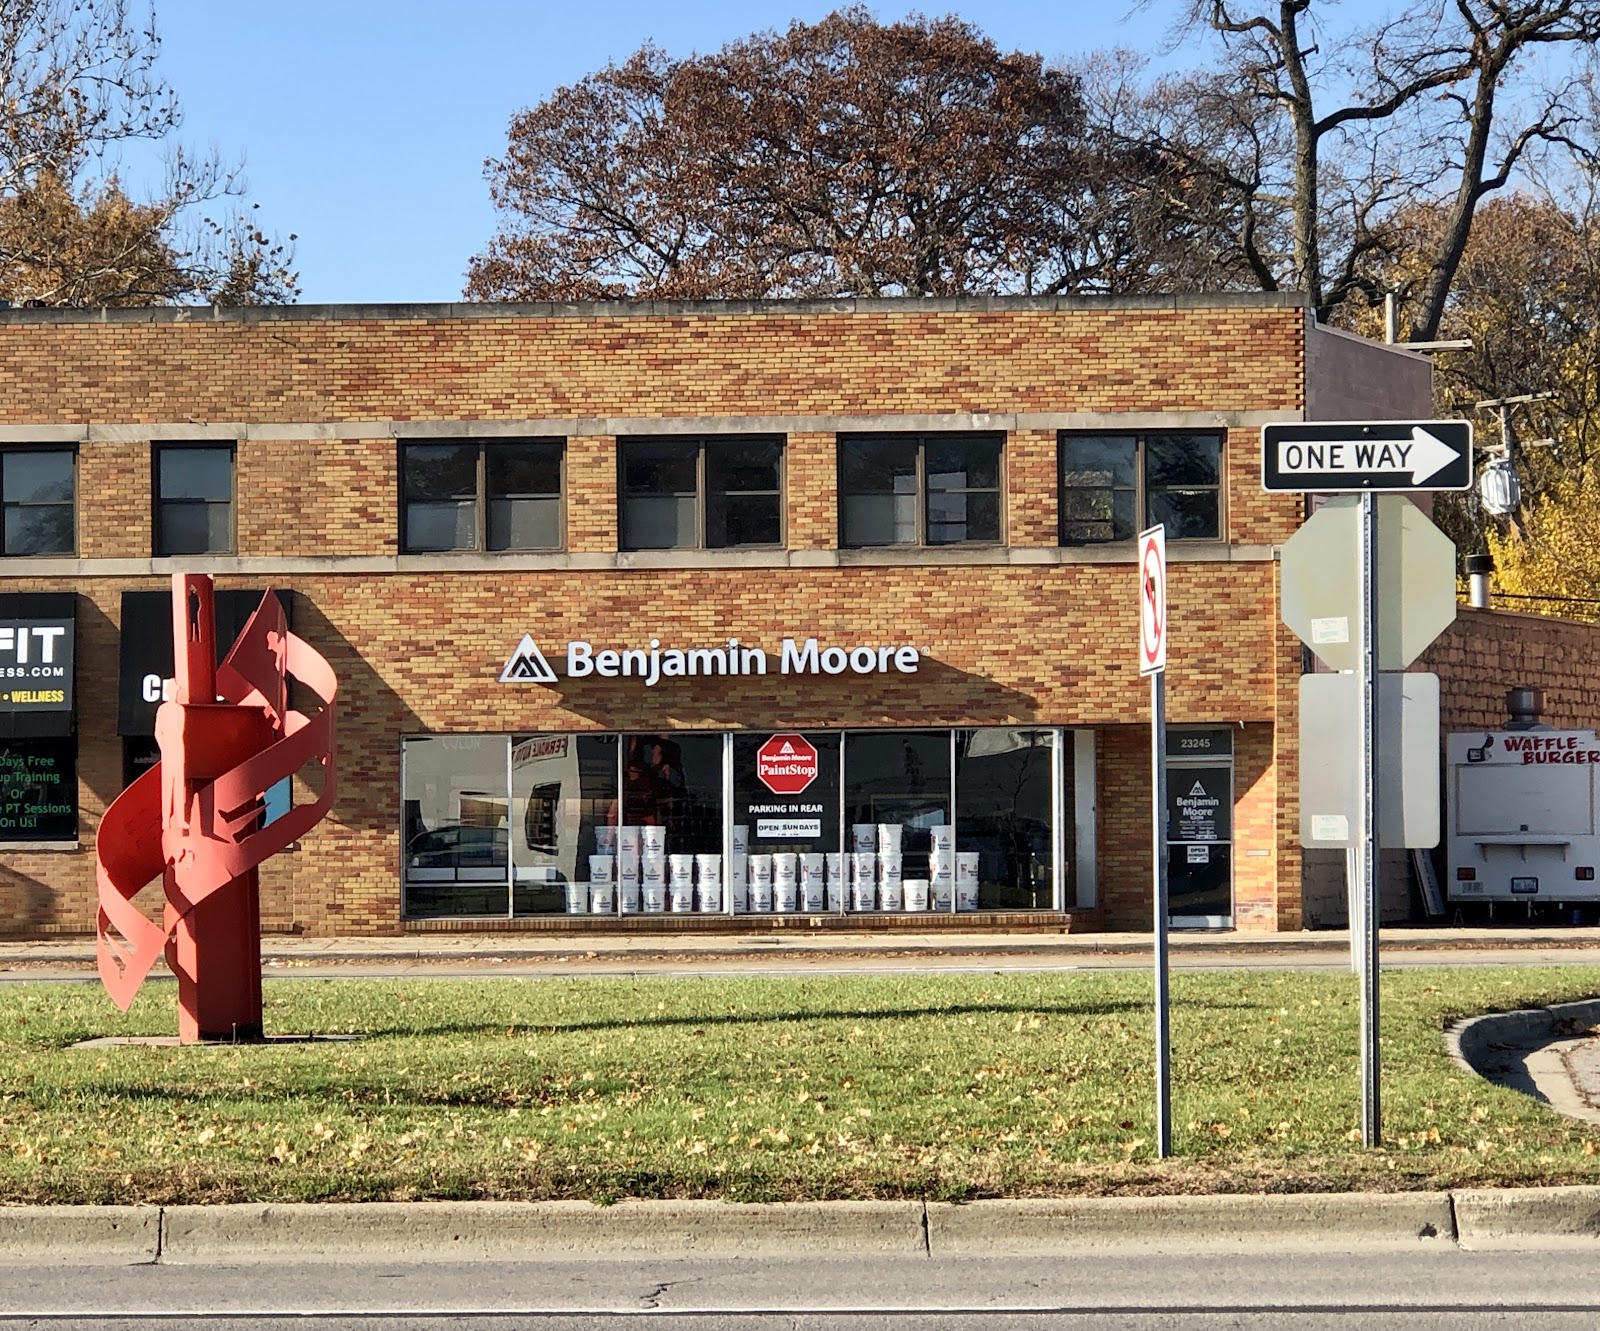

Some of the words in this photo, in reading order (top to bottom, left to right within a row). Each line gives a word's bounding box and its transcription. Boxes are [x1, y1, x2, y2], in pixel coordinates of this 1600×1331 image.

[1285, 444, 1344, 470] ONE
[1354, 443, 1414, 469] WAY
[567, 638, 767, 686] Benjamin
[780, 638, 919, 675] Moore
[11, 689, 64, 703] WELLNESS
[1181, 738, 1211, 748] 23245
[28, 755, 55, 766] Free
[761, 754, 791, 762] Benjamin
[1523, 750, 1600, 765] BURGER
[760, 763, 816, 777] PaintStop
[13, 771, 61, 784] Training
[10, 788, 25, 799] Or
[6, 803, 21, 814] PT
[24, 802, 72, 814] Sessions
[1176, 797, 1219, 808] Benjamin
[748, 804, 787, 814] PARKING
[789, 804, 799, 813] IN
[800, 804, 823, 813] REAR
[1182, 807, 1214, 816] Moore
[0, 817, 16, 828] On
[19, 816, 37, 828] Us!
